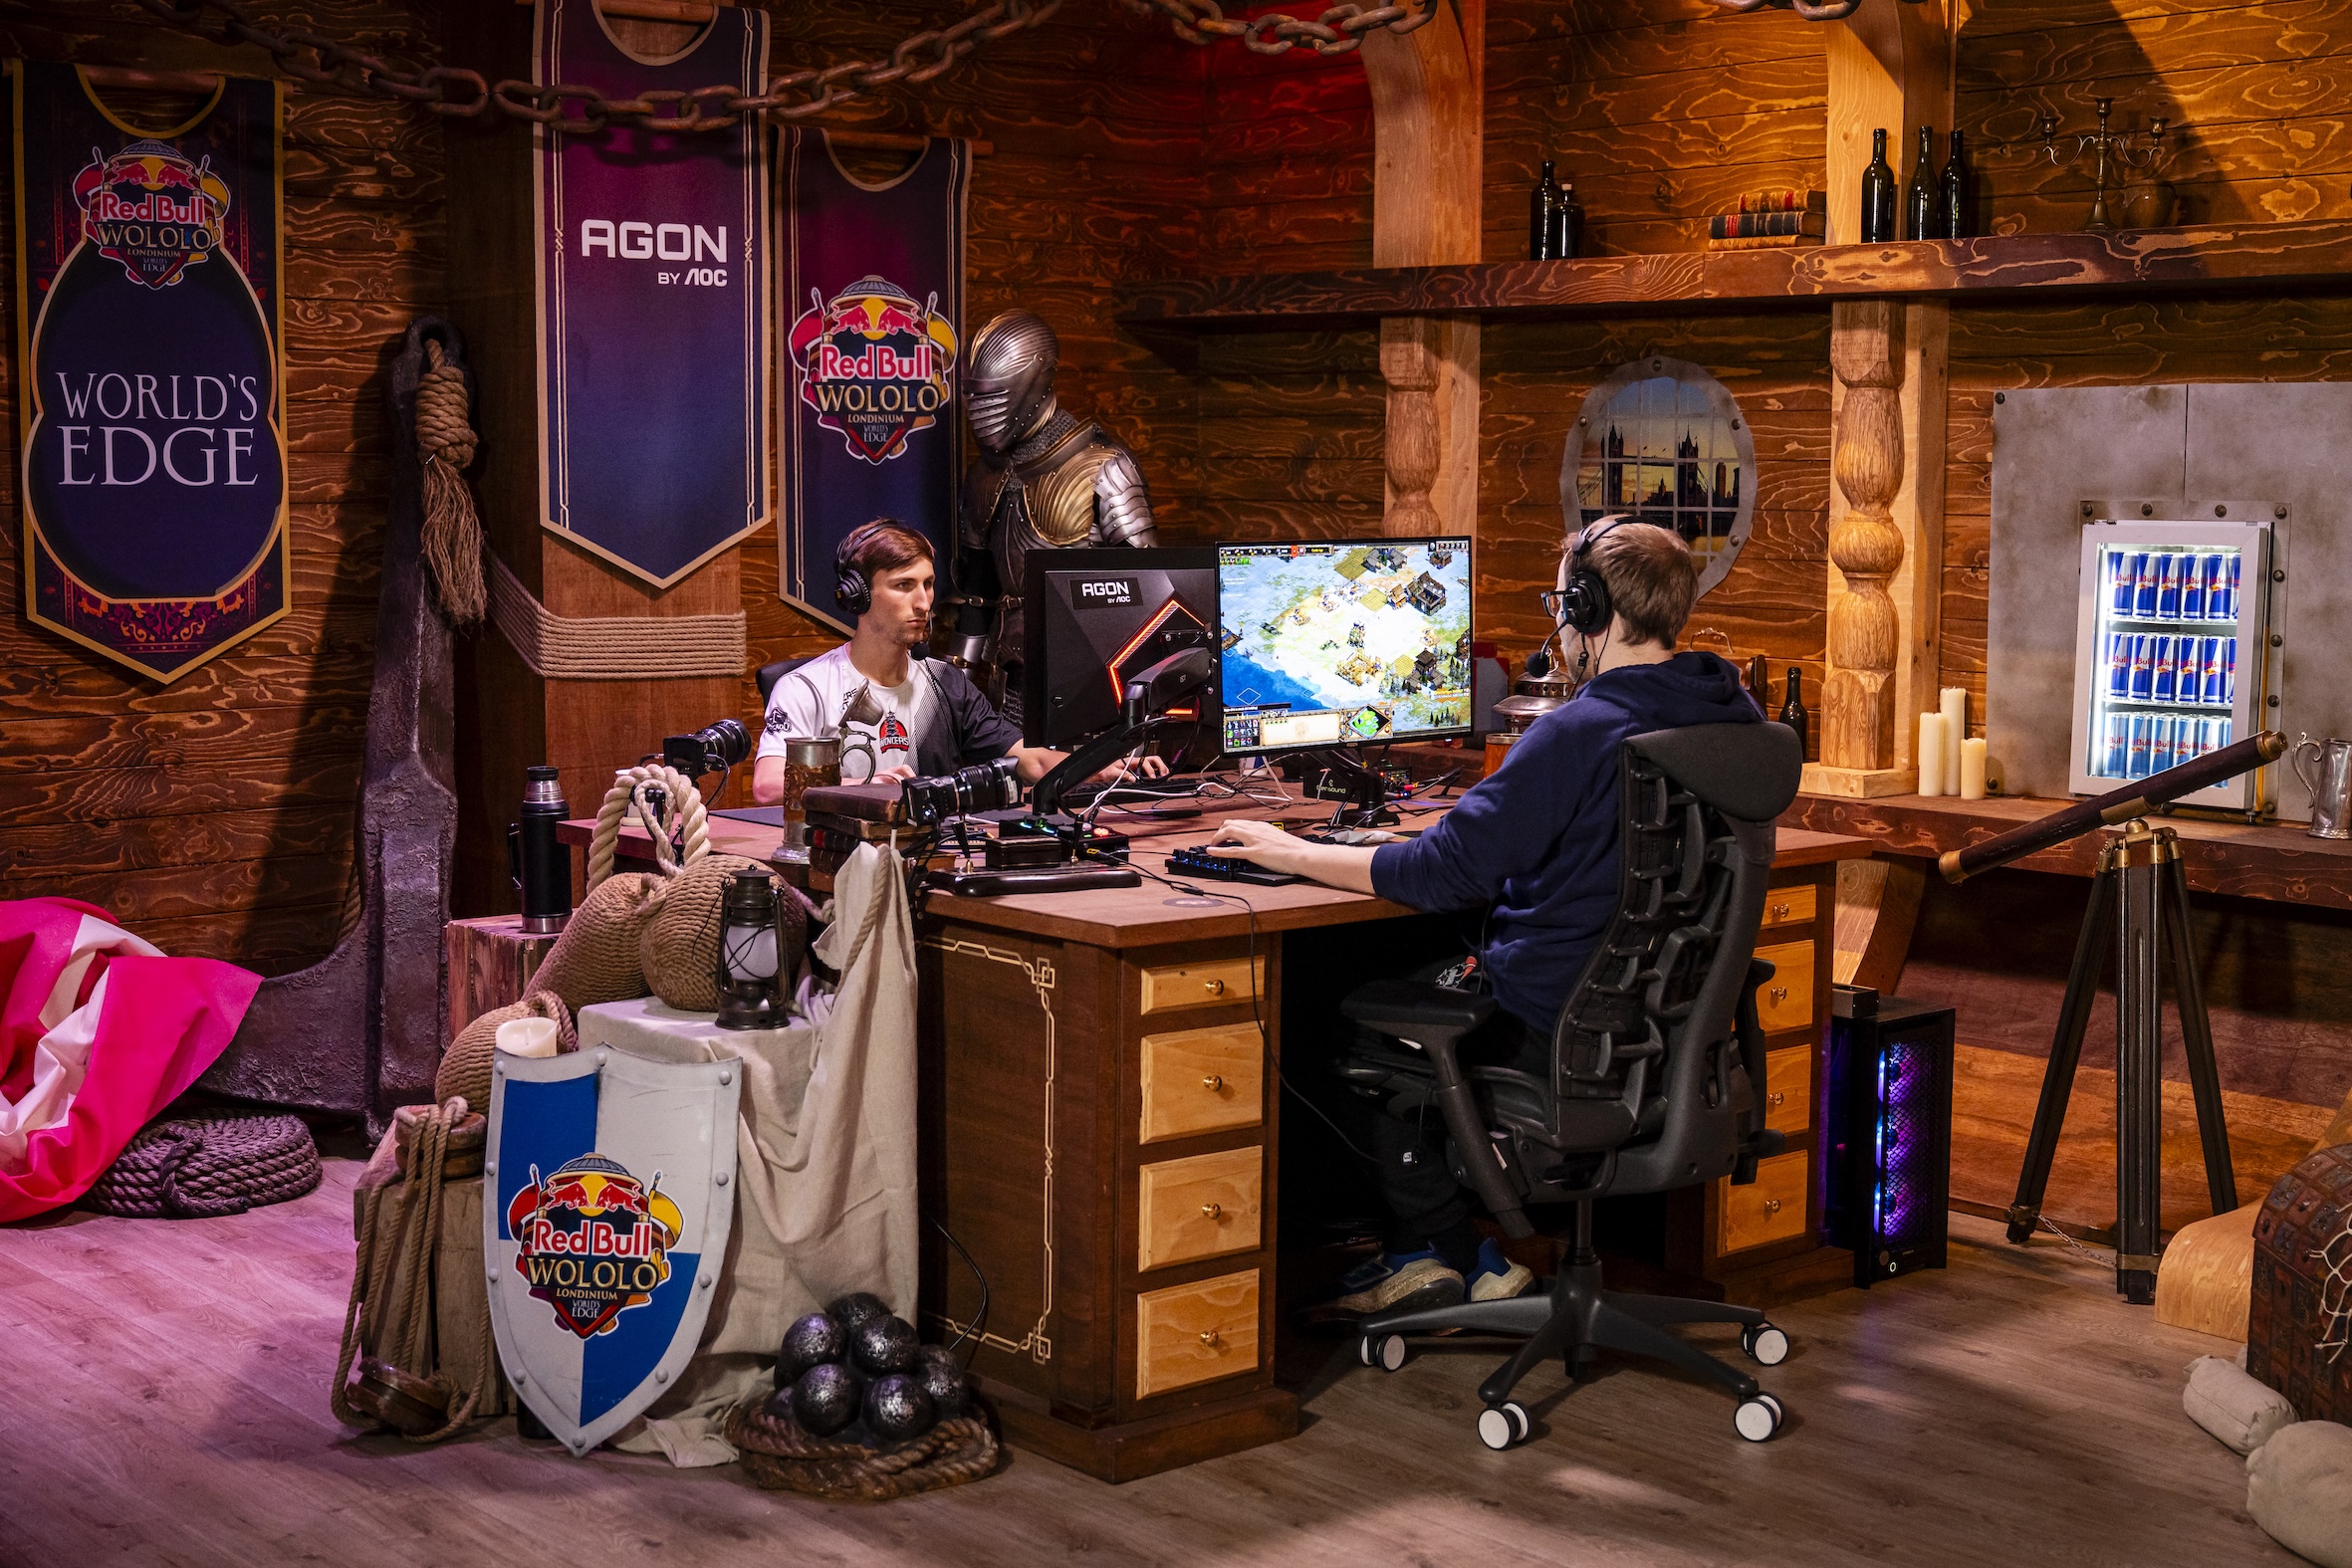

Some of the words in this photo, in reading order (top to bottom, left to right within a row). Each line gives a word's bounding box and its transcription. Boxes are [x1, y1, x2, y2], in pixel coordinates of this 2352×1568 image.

[101, 193, 152, 221] Red
[156, 195, 205, 224] Bull
[97, 223, 213, 250] WOLOLO
[581, 218, 728, 263] AGON
[126, 248, 181, 257] LONDINIUM
[657, 272, 681, 285] BY
[821, 343, 874, 379] Red
[876, 344, 932, 380] Bull
[55, 371, 258, 421] WORLD'S
[815, 384, 939, 412] WOLOLO
[847, 413, 905, 424] LONDINIUM
[863, 432, 888, 442] EDGE
[56, 425, 258, 487] EDGE
[1081, 581, 1130, 597] AGON
[533, 1218, 589, 1255] Red
[592, 1222, 652, 1258] Bull
[526, 1257, 658, 1290] WOLOLO
[556, 1287, 618, 1300] LONDINIUM
[572, 1307, 600, 1318] EDGE
